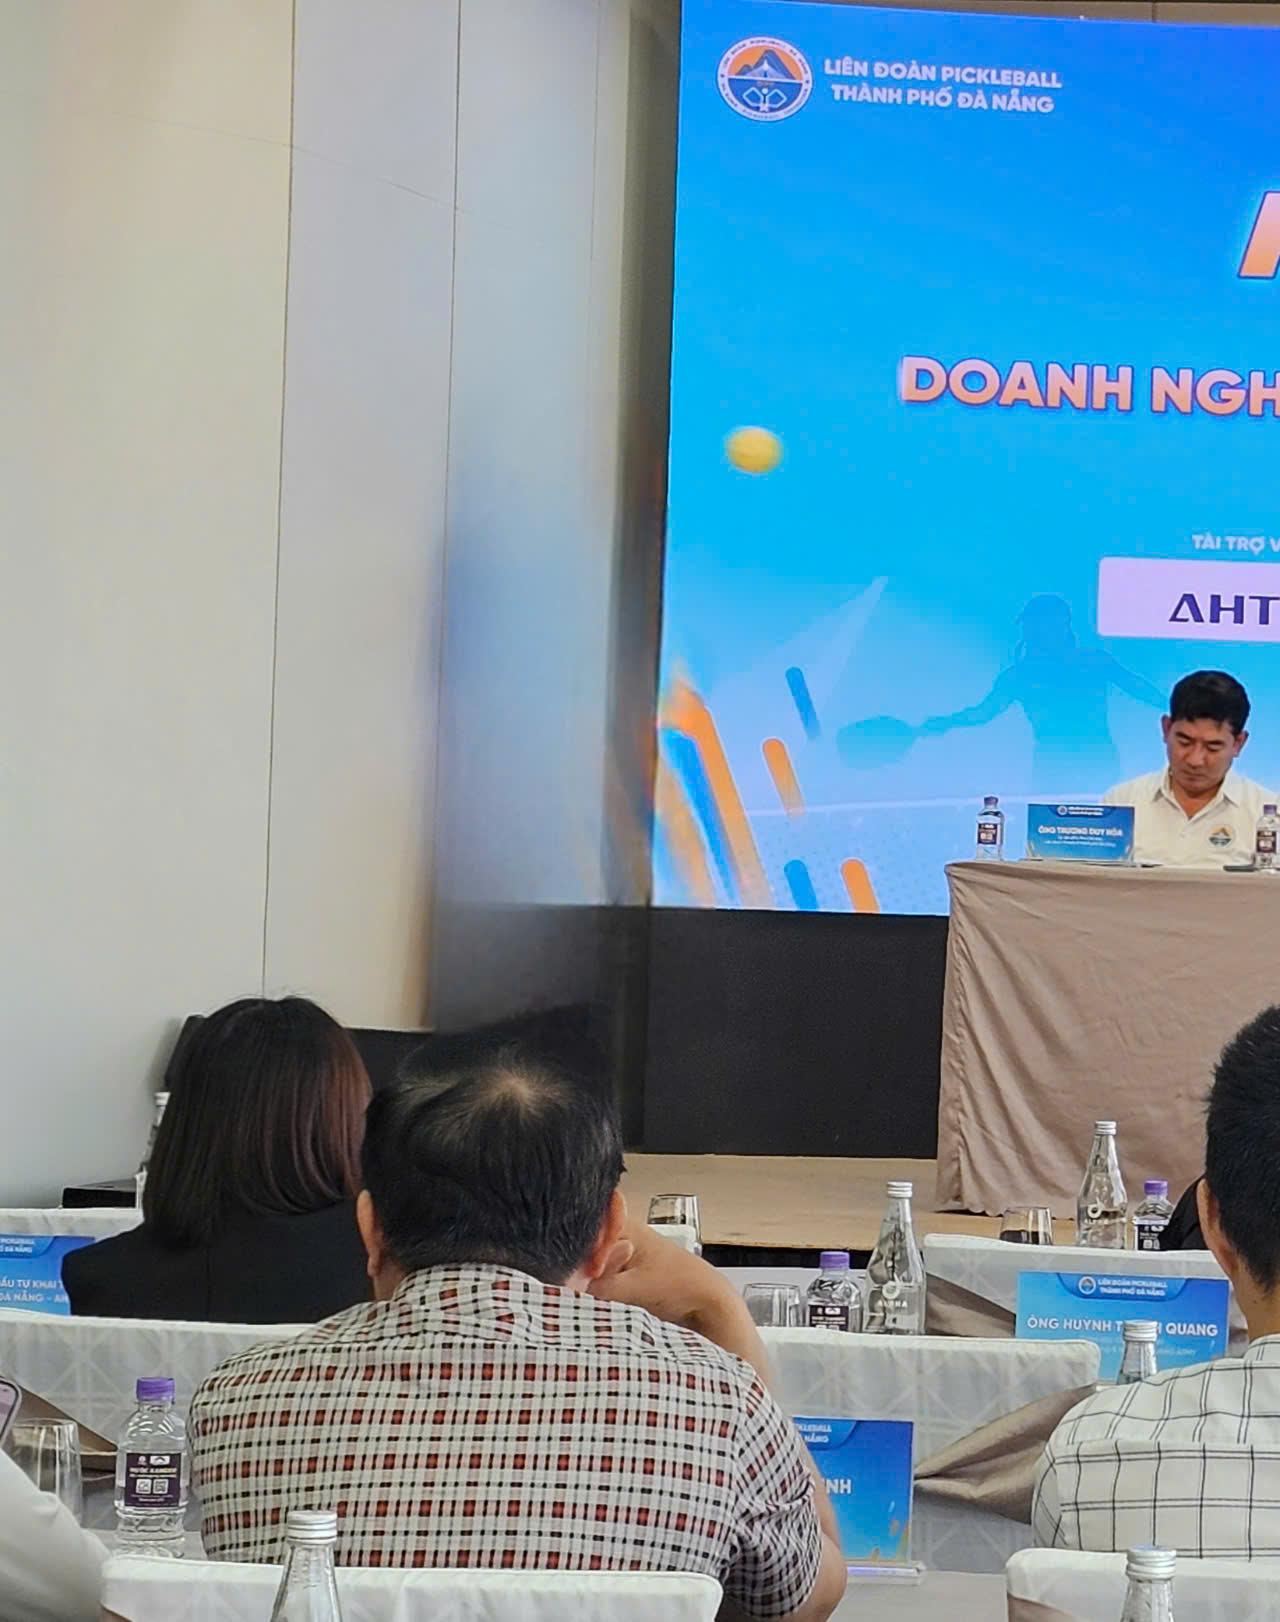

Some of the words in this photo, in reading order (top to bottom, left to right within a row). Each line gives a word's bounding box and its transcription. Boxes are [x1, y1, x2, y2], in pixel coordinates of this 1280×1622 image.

[824, 57, 868, 77] LIÊN
[873, 60, 936, 82] ĐOÀN
[942, 67, 1062, 88] PICKLEBALL
[831, 82, 901, 105] THÀNH
[906, 86, 952, 108] PHỐ
[957, 88, 988, 110] ĐÀ
[900, 355, 1132, 412] DOANH
[1192, 531, 1221, 550] TÀI
[1225, 535, 1266, 557] TRỢ
[1168, 593, 1280, 625] AHT
[1027, 1313, 1059, 1329] ÔNG
[1165, 1322, 1218, 1337] QUANG
